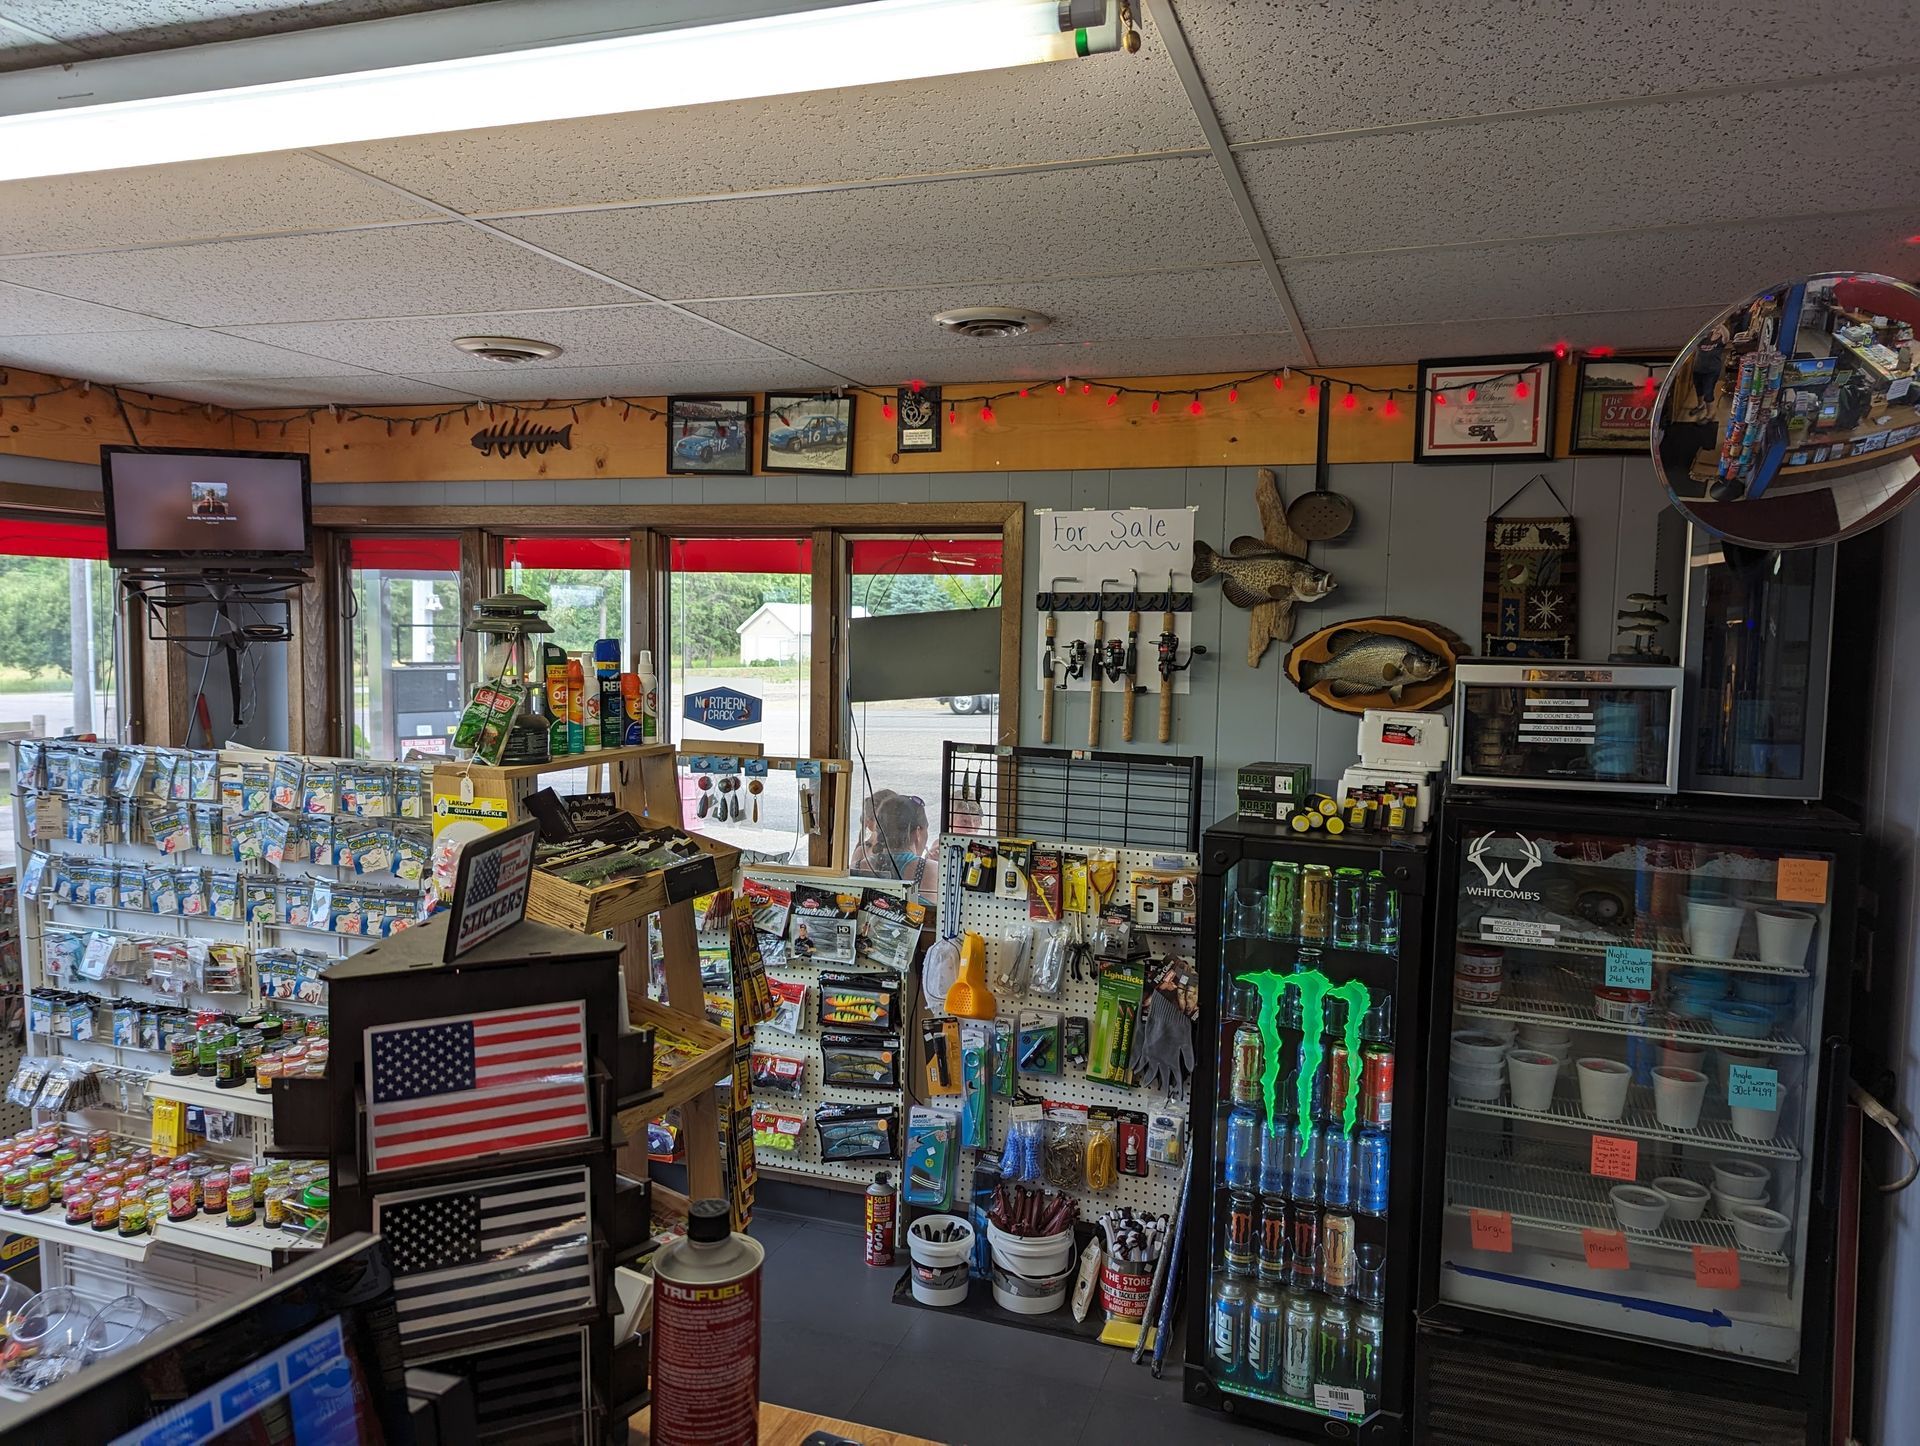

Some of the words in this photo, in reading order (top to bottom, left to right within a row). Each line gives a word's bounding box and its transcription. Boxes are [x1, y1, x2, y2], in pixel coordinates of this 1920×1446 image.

[806, 430, 821, 442] 16
[1054, 516, 1087, 542] For
[1110, 512, 1167, 540] Sale
[707, 710, 735, 721] CRACK
[1239, 774, 1270, 784] NORSK
[1240, 800, 1271, 810] NORSK
[1466, 886, 1541, 901] WHITCOMB'S
[460, 886, 524, 940] STICKERS
[1607, 949, 1629, 963] Night
[1103, 970, 1144, 985] Lightsticks
[1476, 1217, 1505, 1237] Large
[1698, 1261, 1733, 1276] Small
[1105, 1270, 1120, 1283] THE
[1122, 1276, 1151, 1287] STORE
[662, 1283, 744, 1301] TRUFUEL
[1119, 1291, 1137, 1300] TACKLE
